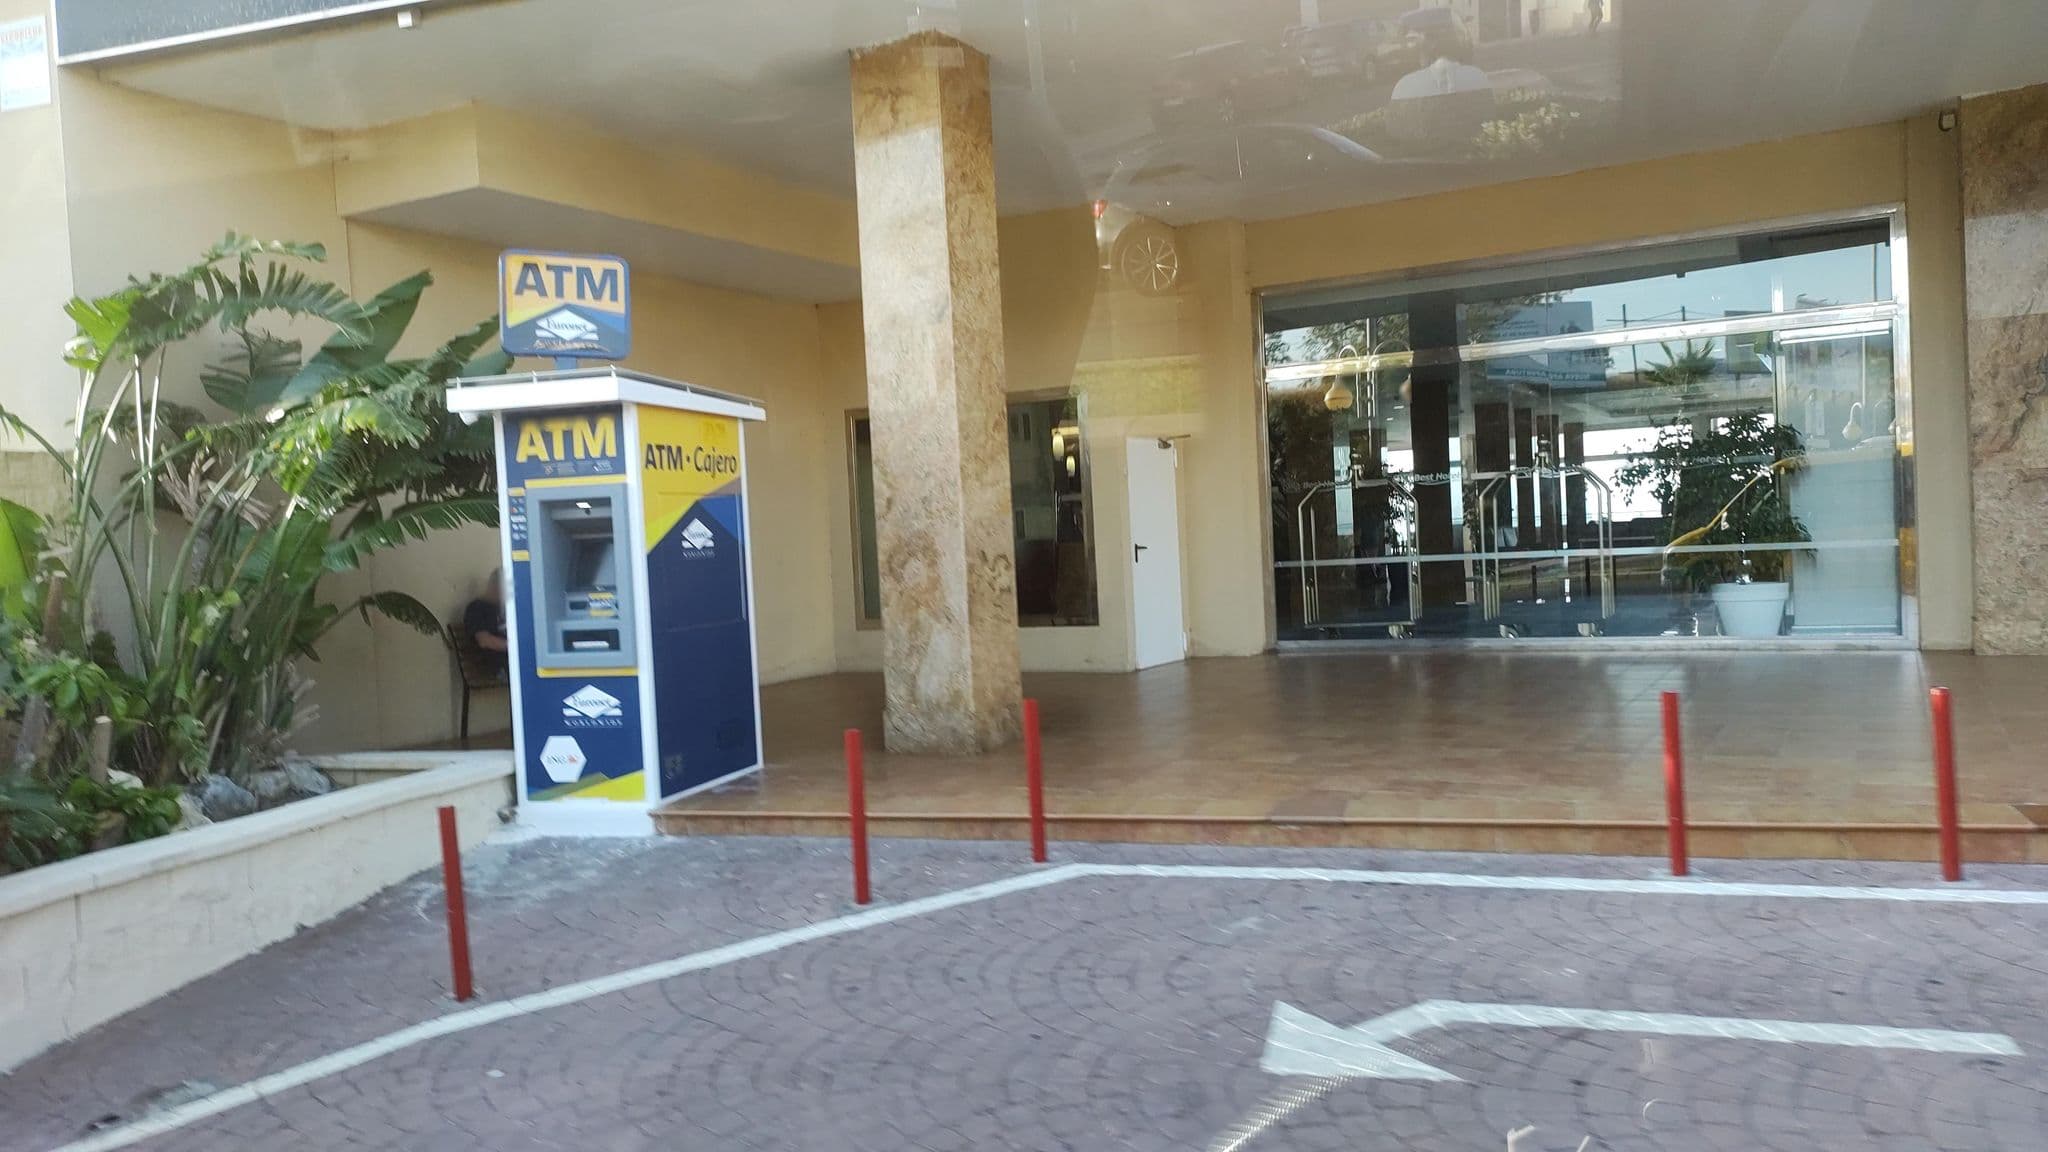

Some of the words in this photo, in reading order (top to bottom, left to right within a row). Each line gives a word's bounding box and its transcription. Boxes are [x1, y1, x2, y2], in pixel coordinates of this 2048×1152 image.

[514, 262, 618, 303] ATM
[515, 415, 617, 463] ATM
[644, 443, 684, 472] ATM
[693, 445, 737, 480] Cajero
